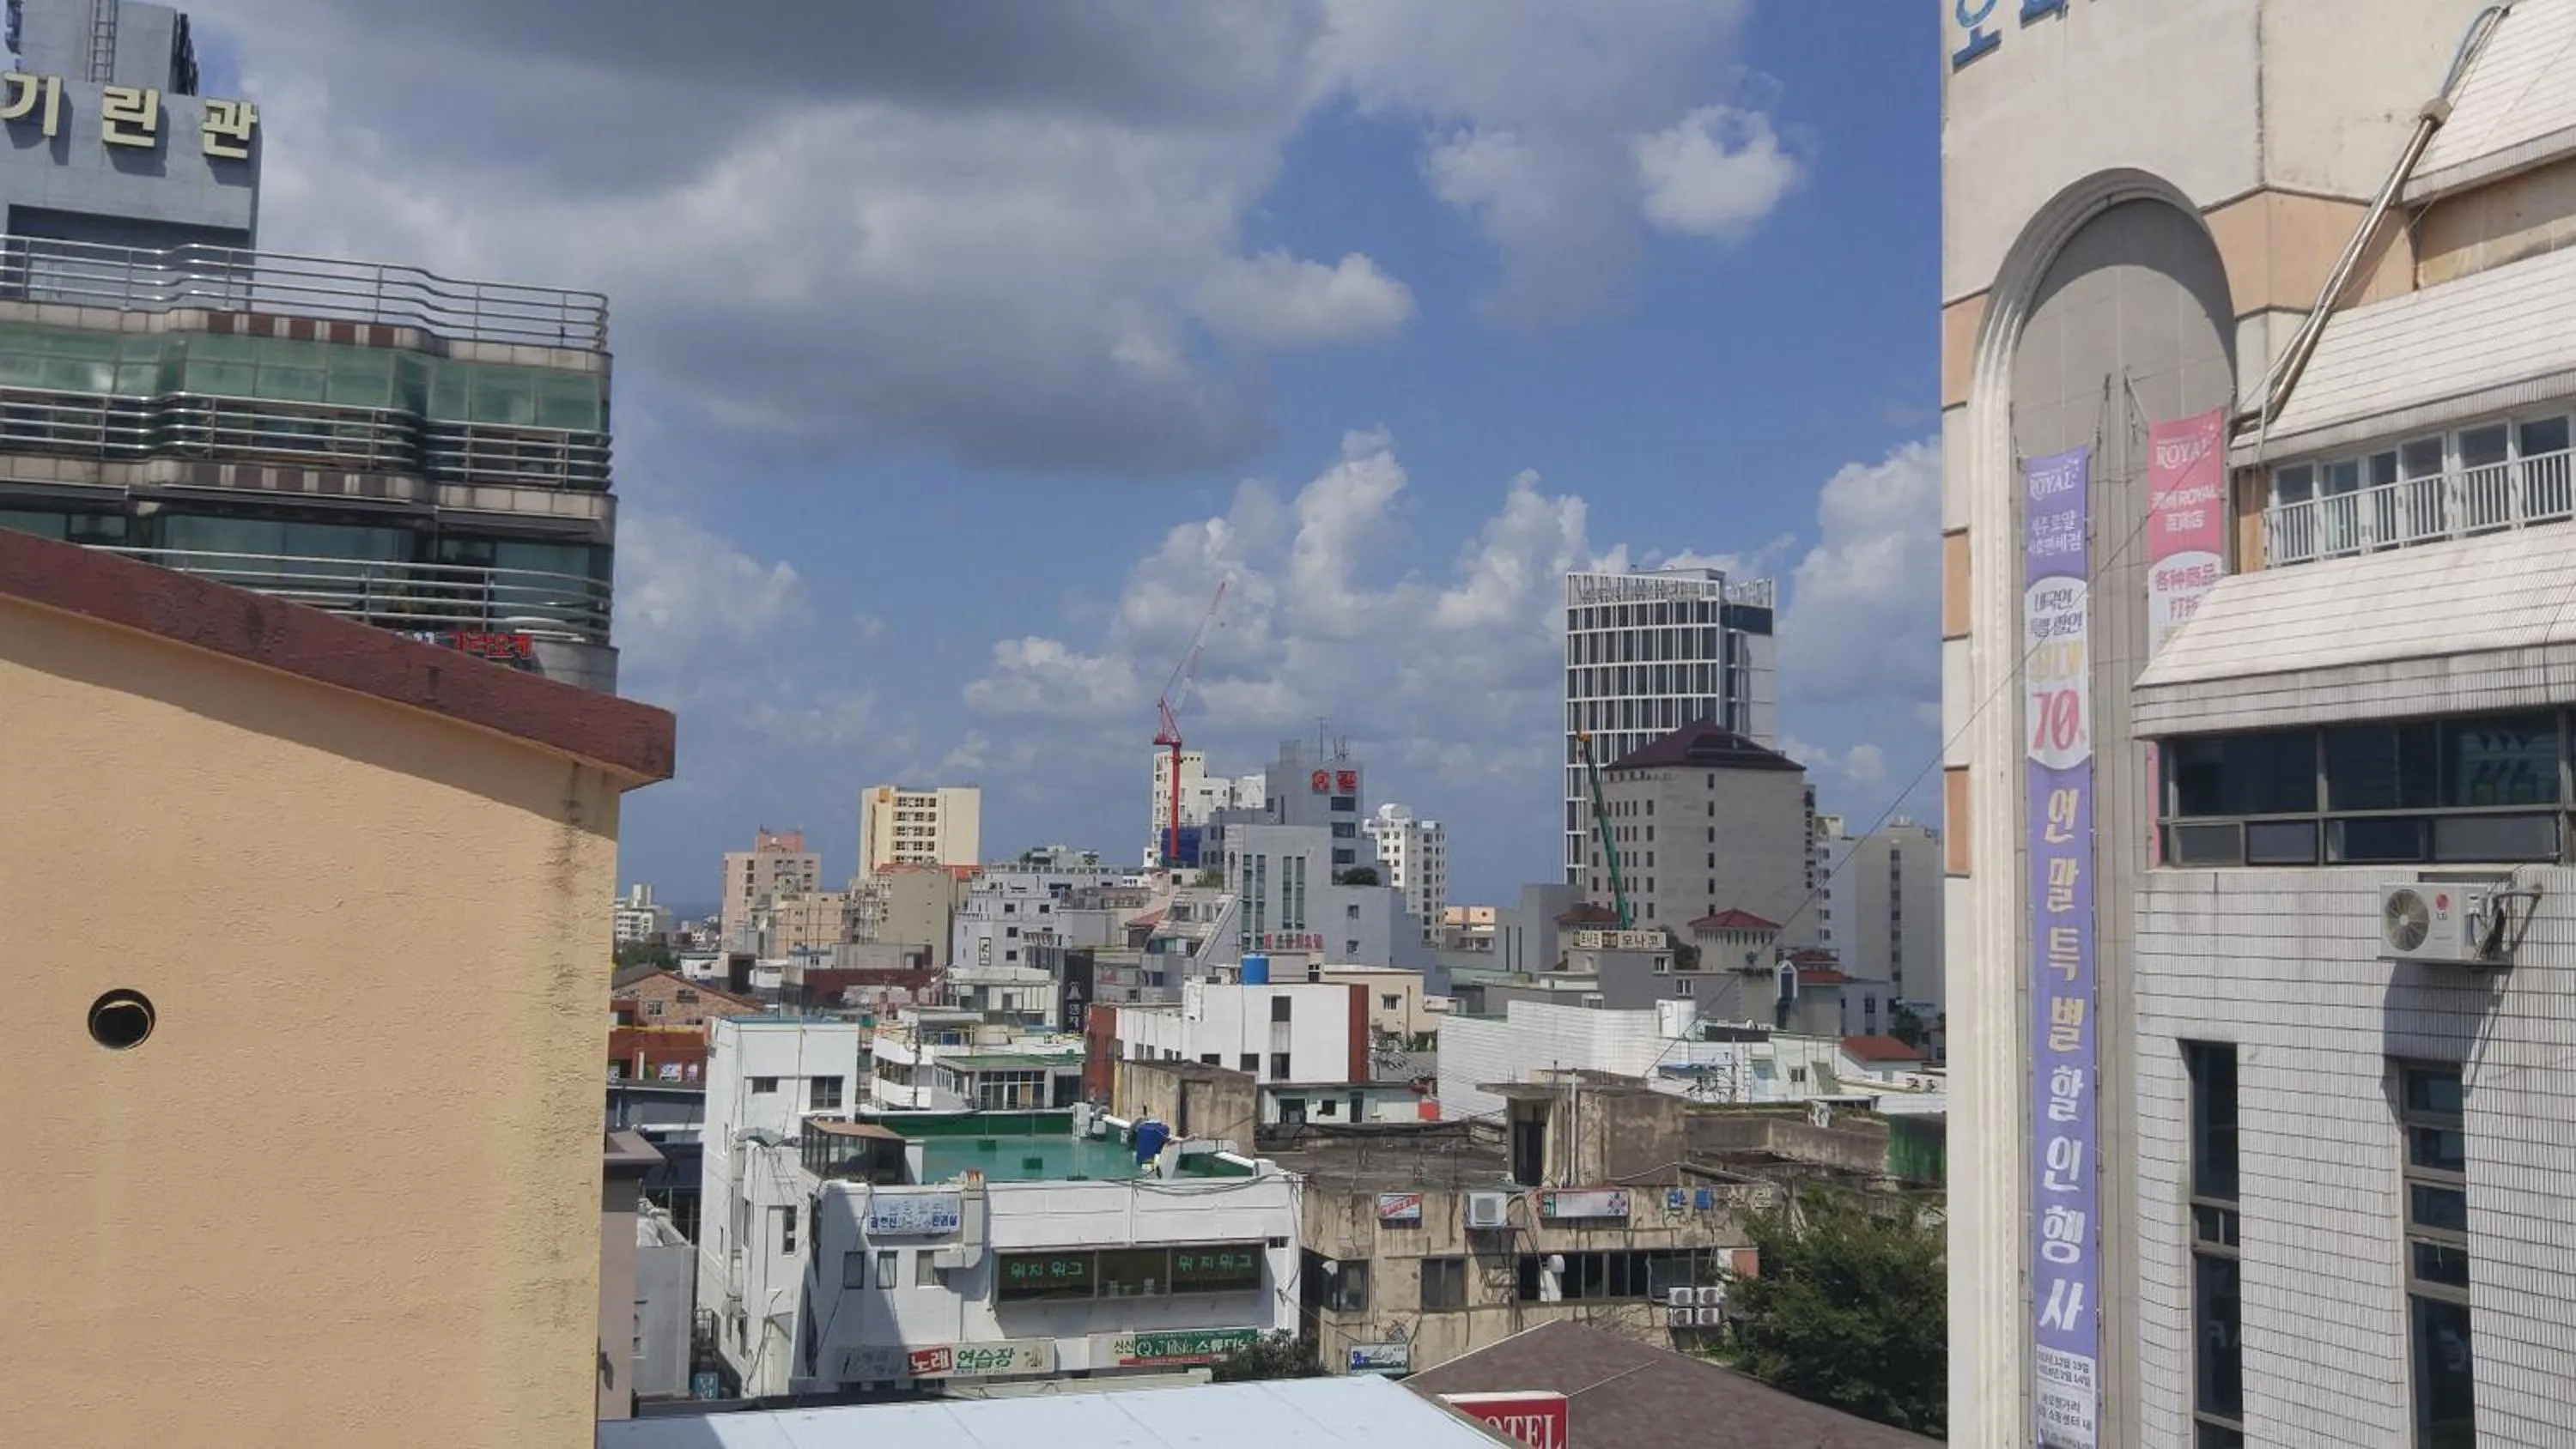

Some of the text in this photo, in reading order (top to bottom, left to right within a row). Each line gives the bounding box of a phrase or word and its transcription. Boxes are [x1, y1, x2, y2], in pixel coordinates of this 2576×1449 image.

[0, 70, 258, 160] 기린관
[2155, 441, 2212, 470] ROYAL
[911, 1347, 951, 1372] 노래
[957, 1347, 1015, 1369] 연습장
